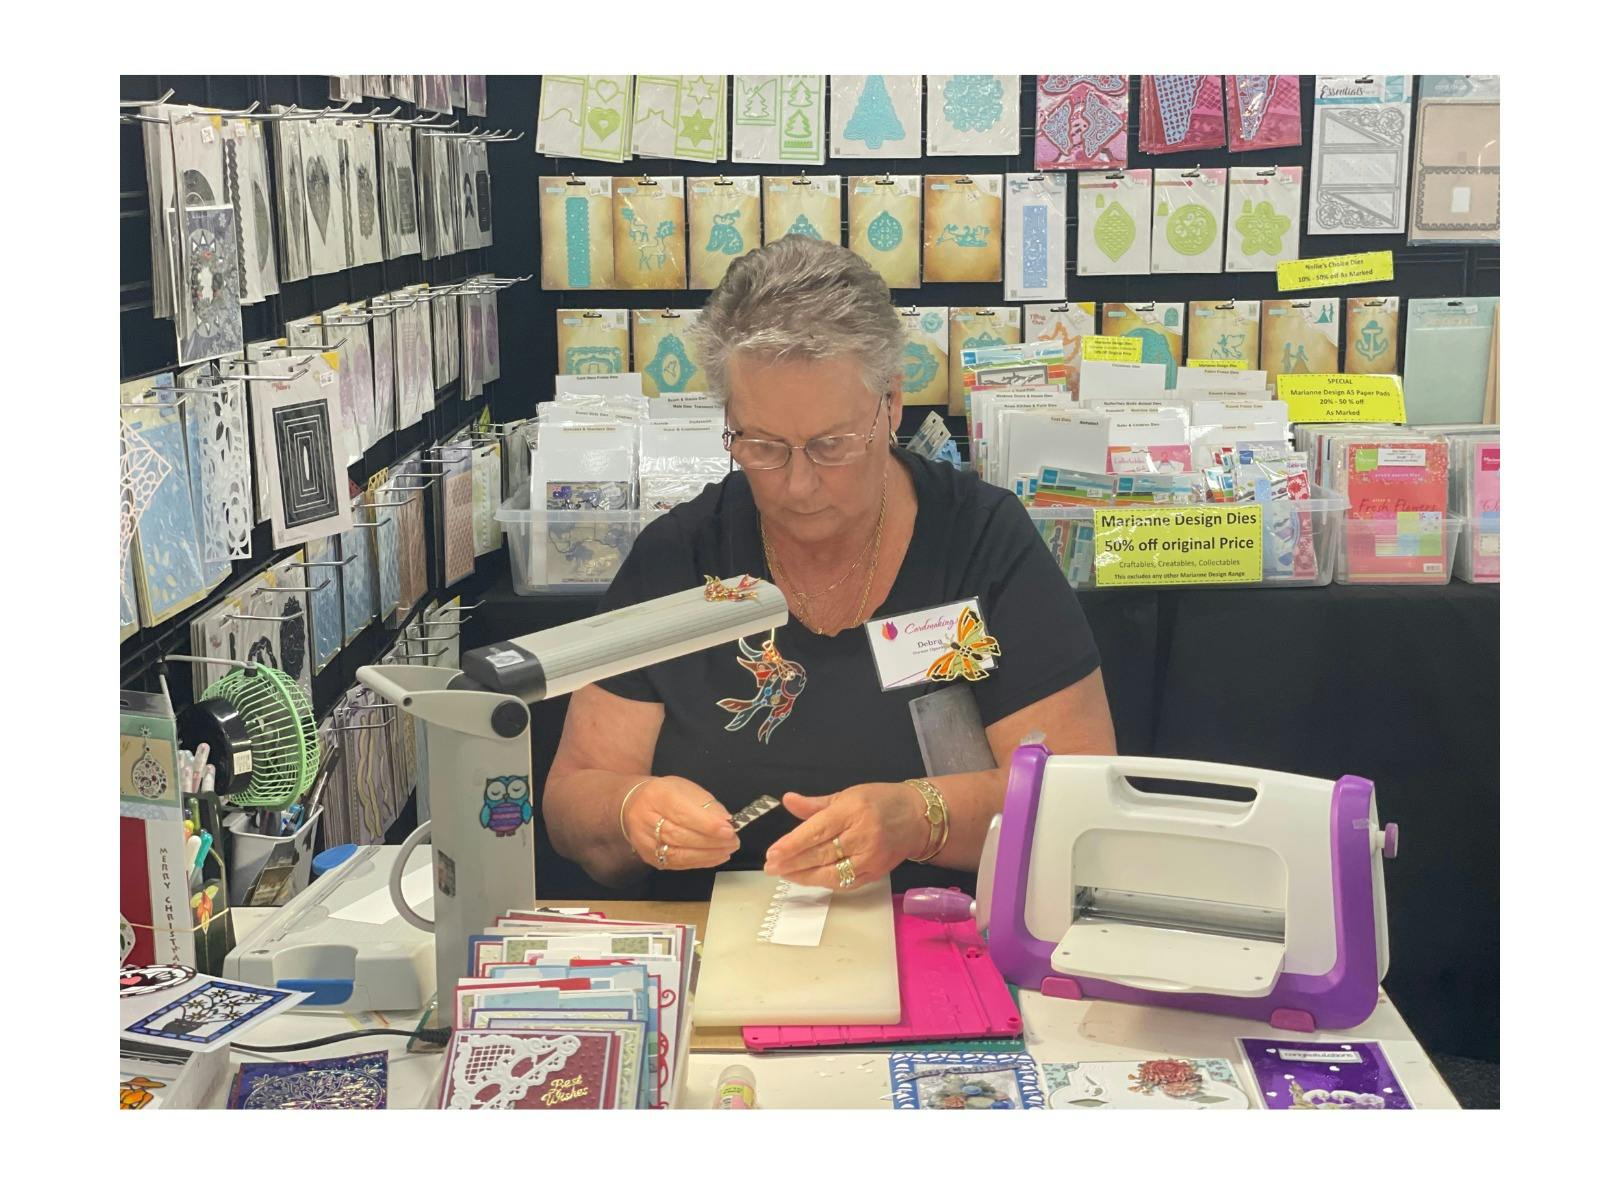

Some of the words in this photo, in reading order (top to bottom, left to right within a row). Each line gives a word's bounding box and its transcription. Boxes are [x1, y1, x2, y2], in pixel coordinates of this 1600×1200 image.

[1320, 85, 1364, 99] Essentials
[1349, 268, 1373, 277] Marked
[1359, 498, 1389, 513] Fresh
[1101, 513, 1171, 528] Marianne
[1174, 513, 1222, 528] Design
[1226, 512, 1257, 525] Dies
[1104, 538, 1135, 552] 50%
[1138, 537, 1158, 551] off
[1161, 536, 1215, 553] original
[1219, 537, 1254, 550] Price
[1119, 560, 1157, 569] Craftables,
[1157, 559, 1197, 568] Creatables,
[1198, 558, 1240, 567] Collectables
[1208, 571, 1227, 579] Design
[1227, 571, 1246, 579] Range
[159, 847, 171, 889] MERRY
[165, 896, 180, 966] CHRISTMA
[551, 1074, 583, 1088] Best
[541, 1086, 588, 1106] Wishes
